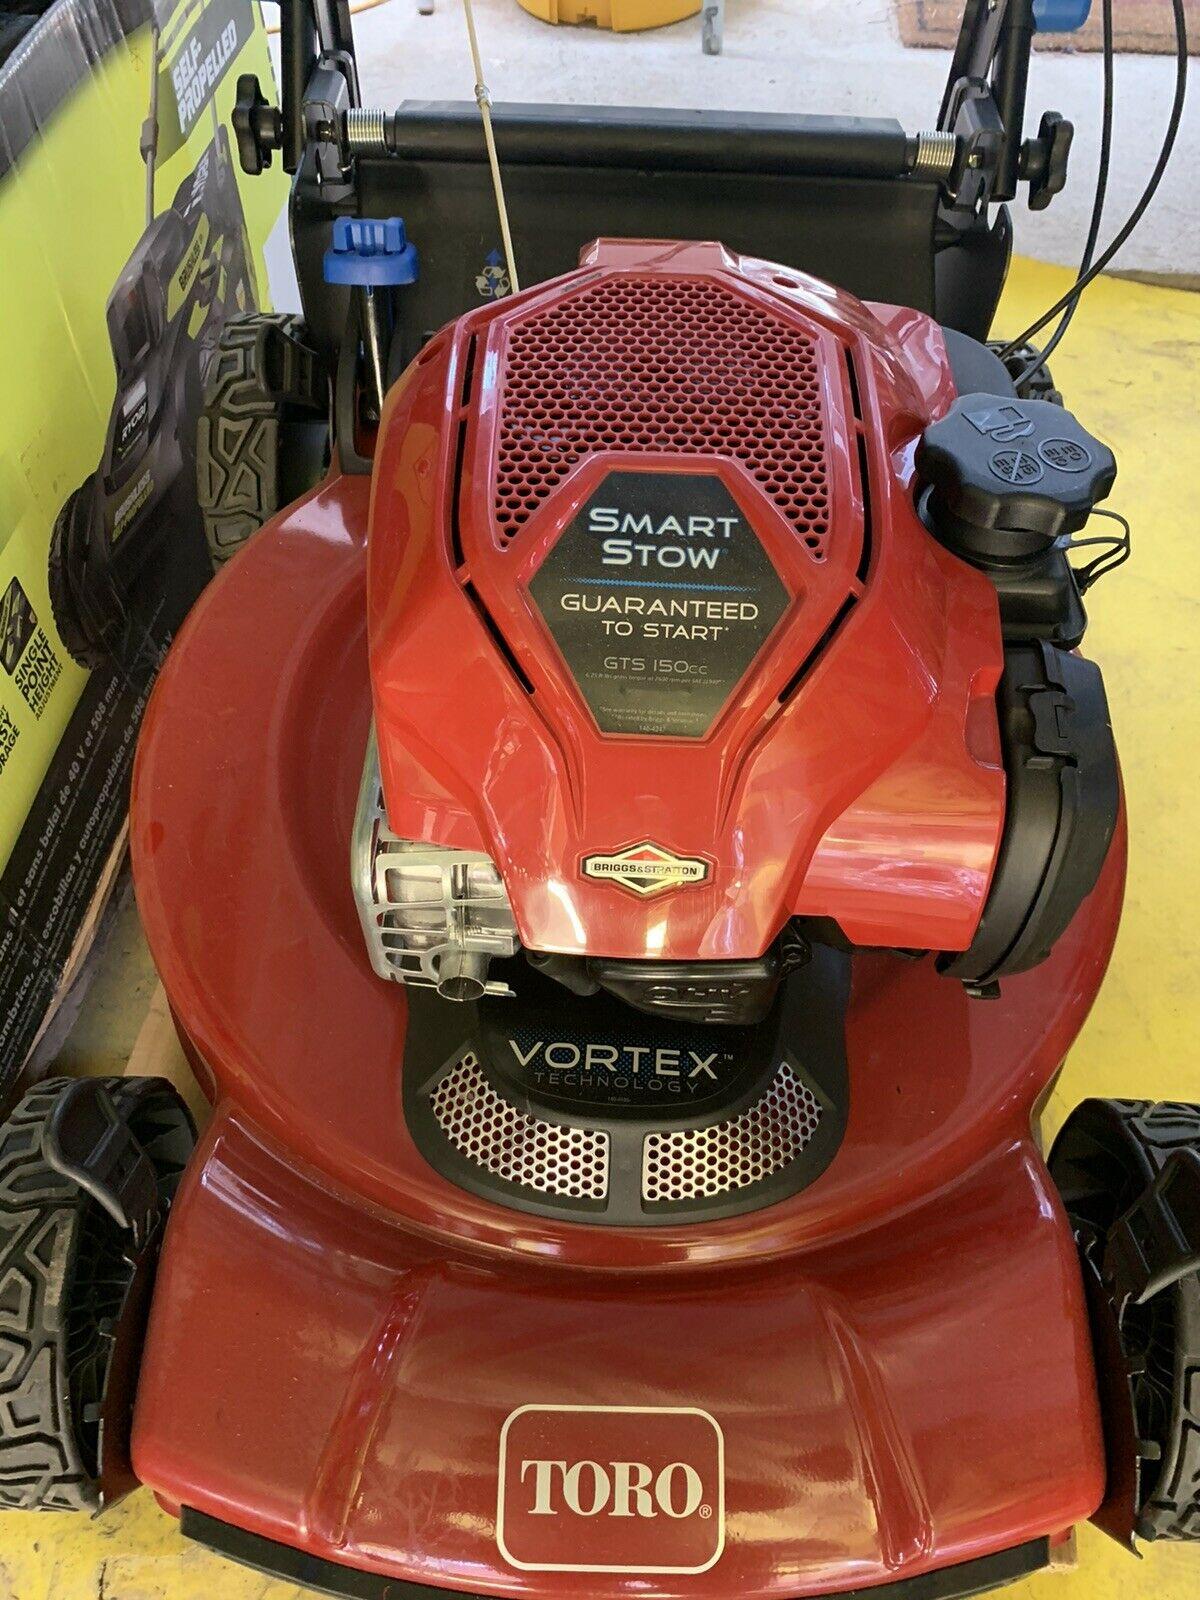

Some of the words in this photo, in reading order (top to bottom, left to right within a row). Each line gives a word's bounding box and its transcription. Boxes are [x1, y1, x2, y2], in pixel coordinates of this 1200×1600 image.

[178, 19, 237, 134] PROPELLED
[589, 508, 739, 538] SMART
[602, 539, 721, 570] STOW
[560, 593, 759, 620] GUARANTEED
[601, 620, 633, 636] TO
[14, 627, 46, 690] SINGLE
[21, 640, 54, 702] POINT
[29, 653, 59, 713] HEIGHT
[603, 656, 646, 671] GTS
[652, 659, 708, 675] 150cc
[35, 663, 64, 721] ADJUSTMENT
[24, 849, 44, 889] sans
[39, 804, 61, 848] balai
[59, 785, 71, 805] de
[68, 760, 80, 782] 40
[76, 745, 86, 760] V
[91, 701, 106, 731] 508
[104, 676, 119, 703] mm
[42, 863, 76, 940] escobillas
[73, 851, 82, 864] y
[123, 725, 135, 744] de
[534, 1072, 699, 1095] TECHNOLOGY
